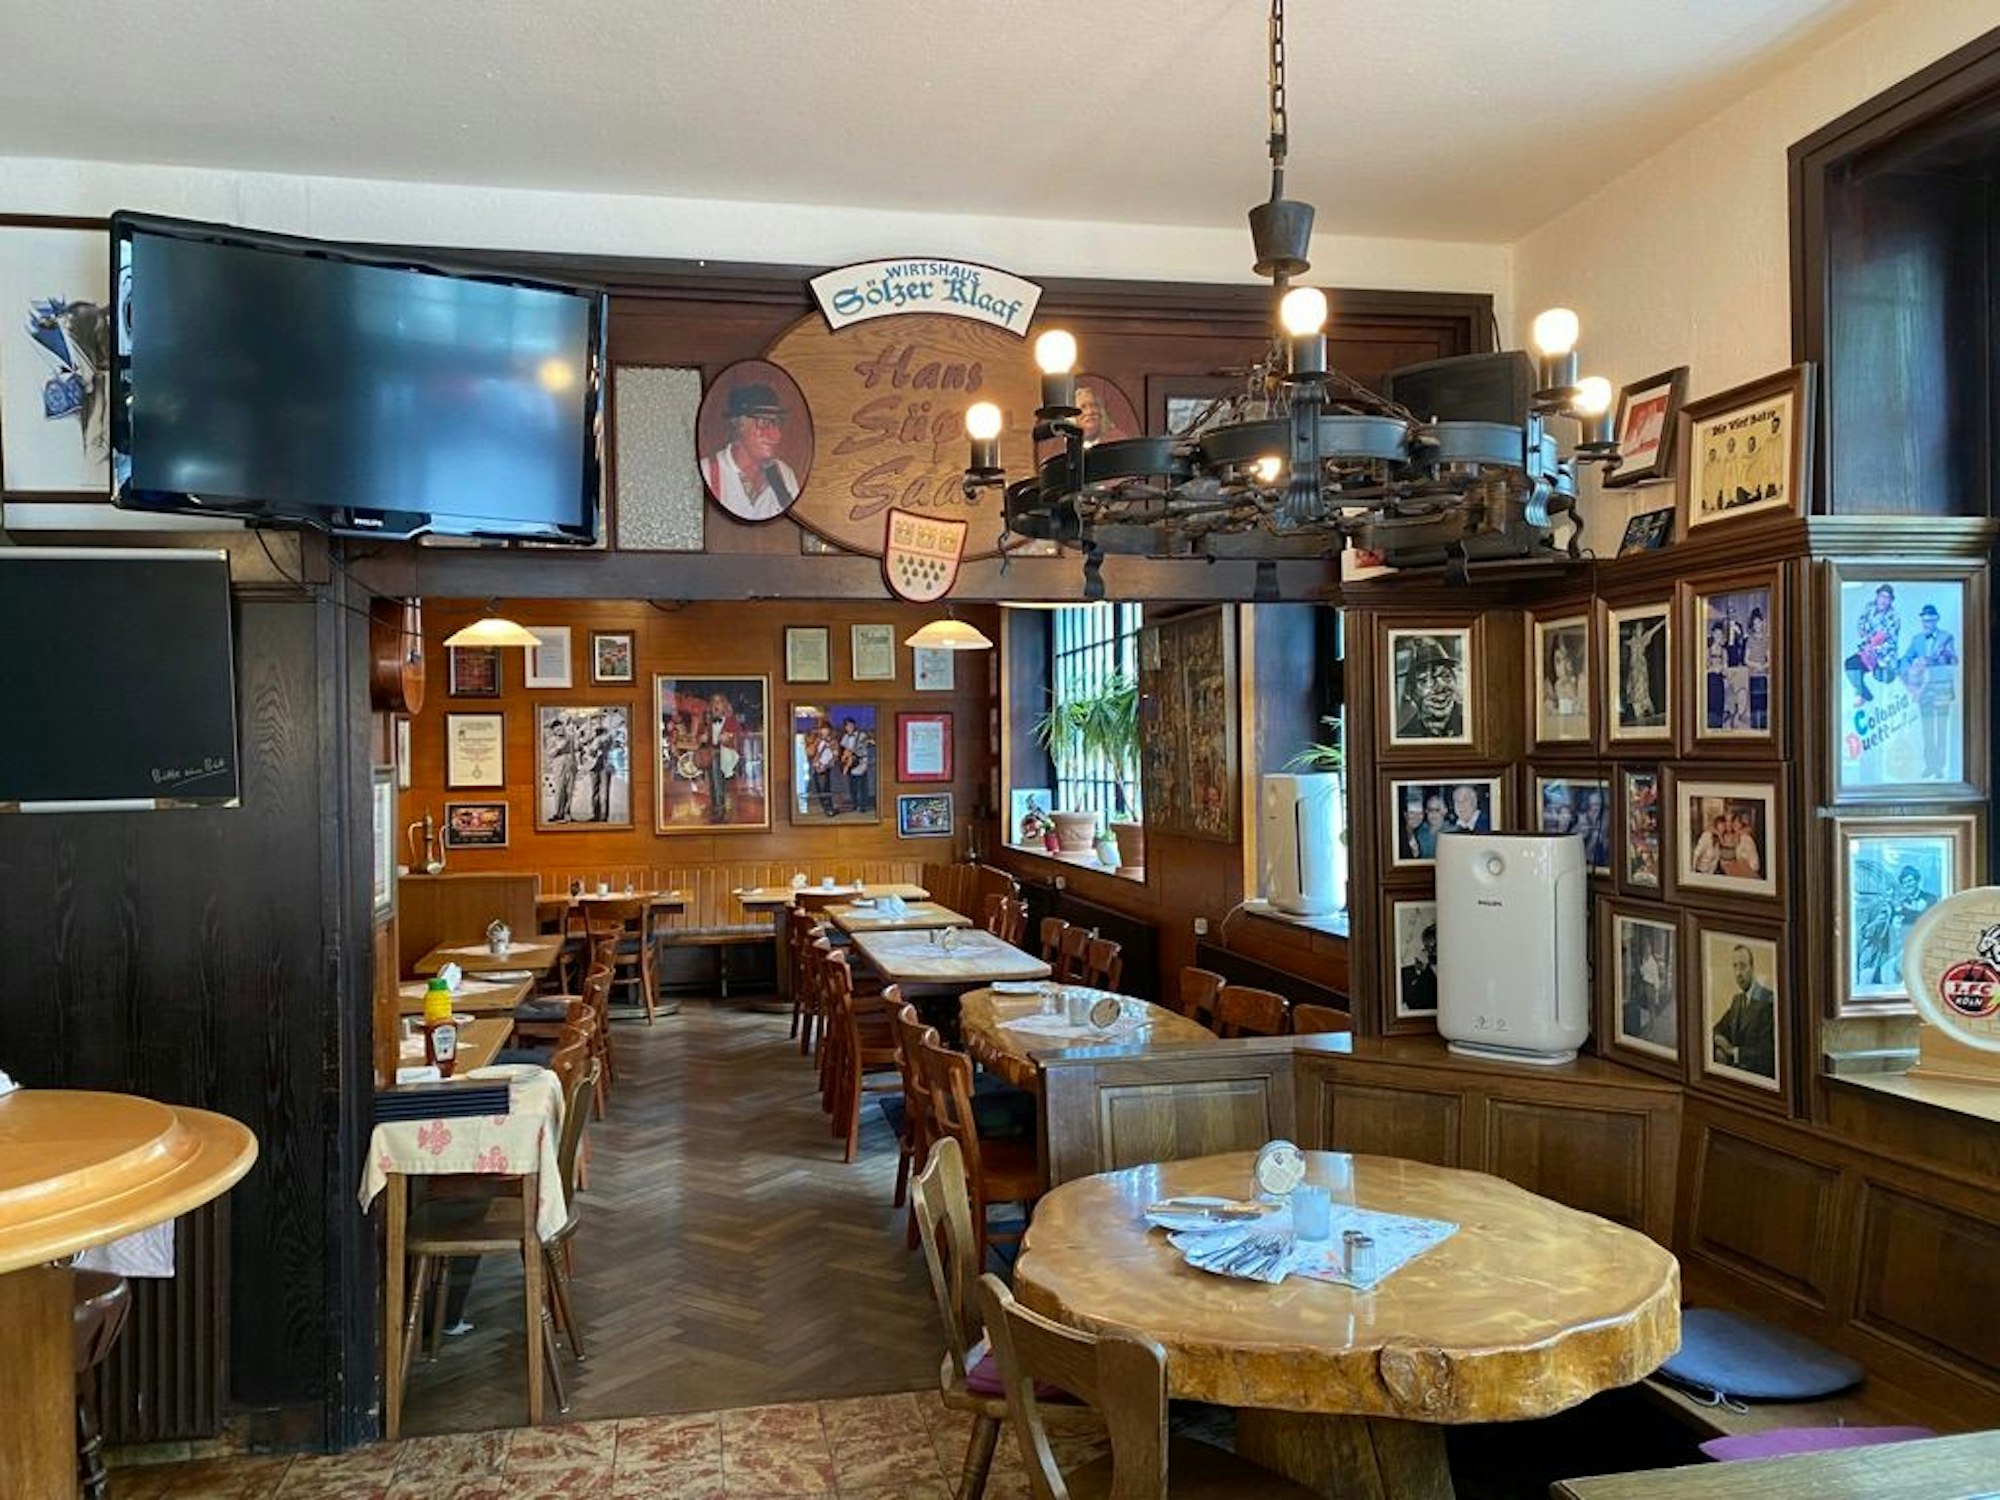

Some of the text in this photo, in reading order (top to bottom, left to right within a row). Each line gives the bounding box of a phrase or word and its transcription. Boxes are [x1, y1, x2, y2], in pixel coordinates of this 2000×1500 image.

[885, 263, 981, 285] WIRTSHAUS
[832, 278, 1023, 326] Sölzer Klaaf
[855, 344, 983, 392] Hans
[850, 455, 985, 521] Saa
[354, 518, 384, 527] PHILIPS
[1854, 694, 1908, 735] Colonia
